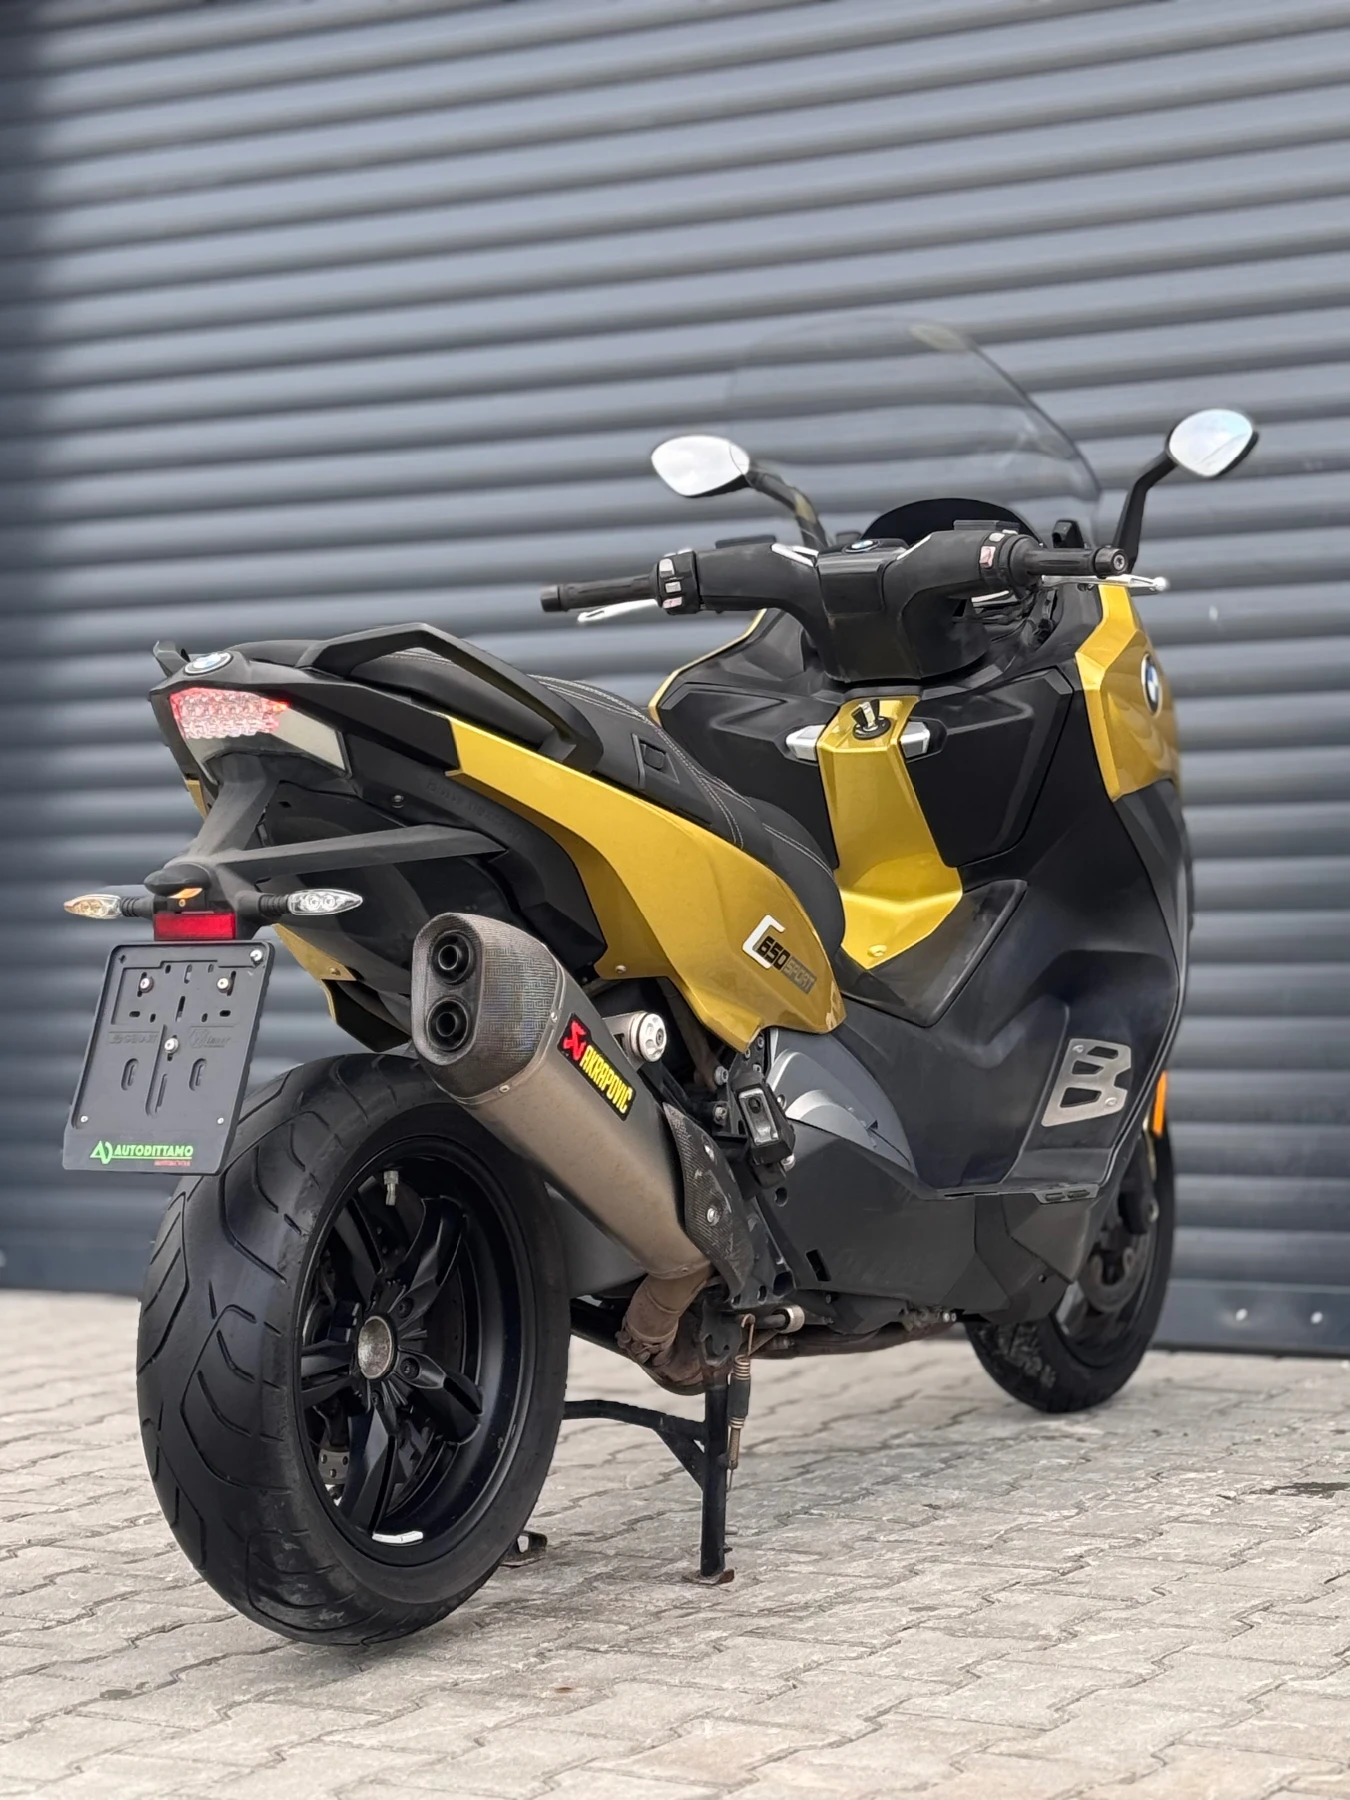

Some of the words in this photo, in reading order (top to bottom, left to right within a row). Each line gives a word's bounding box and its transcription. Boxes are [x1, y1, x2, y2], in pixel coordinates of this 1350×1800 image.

[756, 935, 791, 971] 650
[782, 957, 817, 994] SPORT
[114, 1144, 194, 1157] AUTODITTAMO
